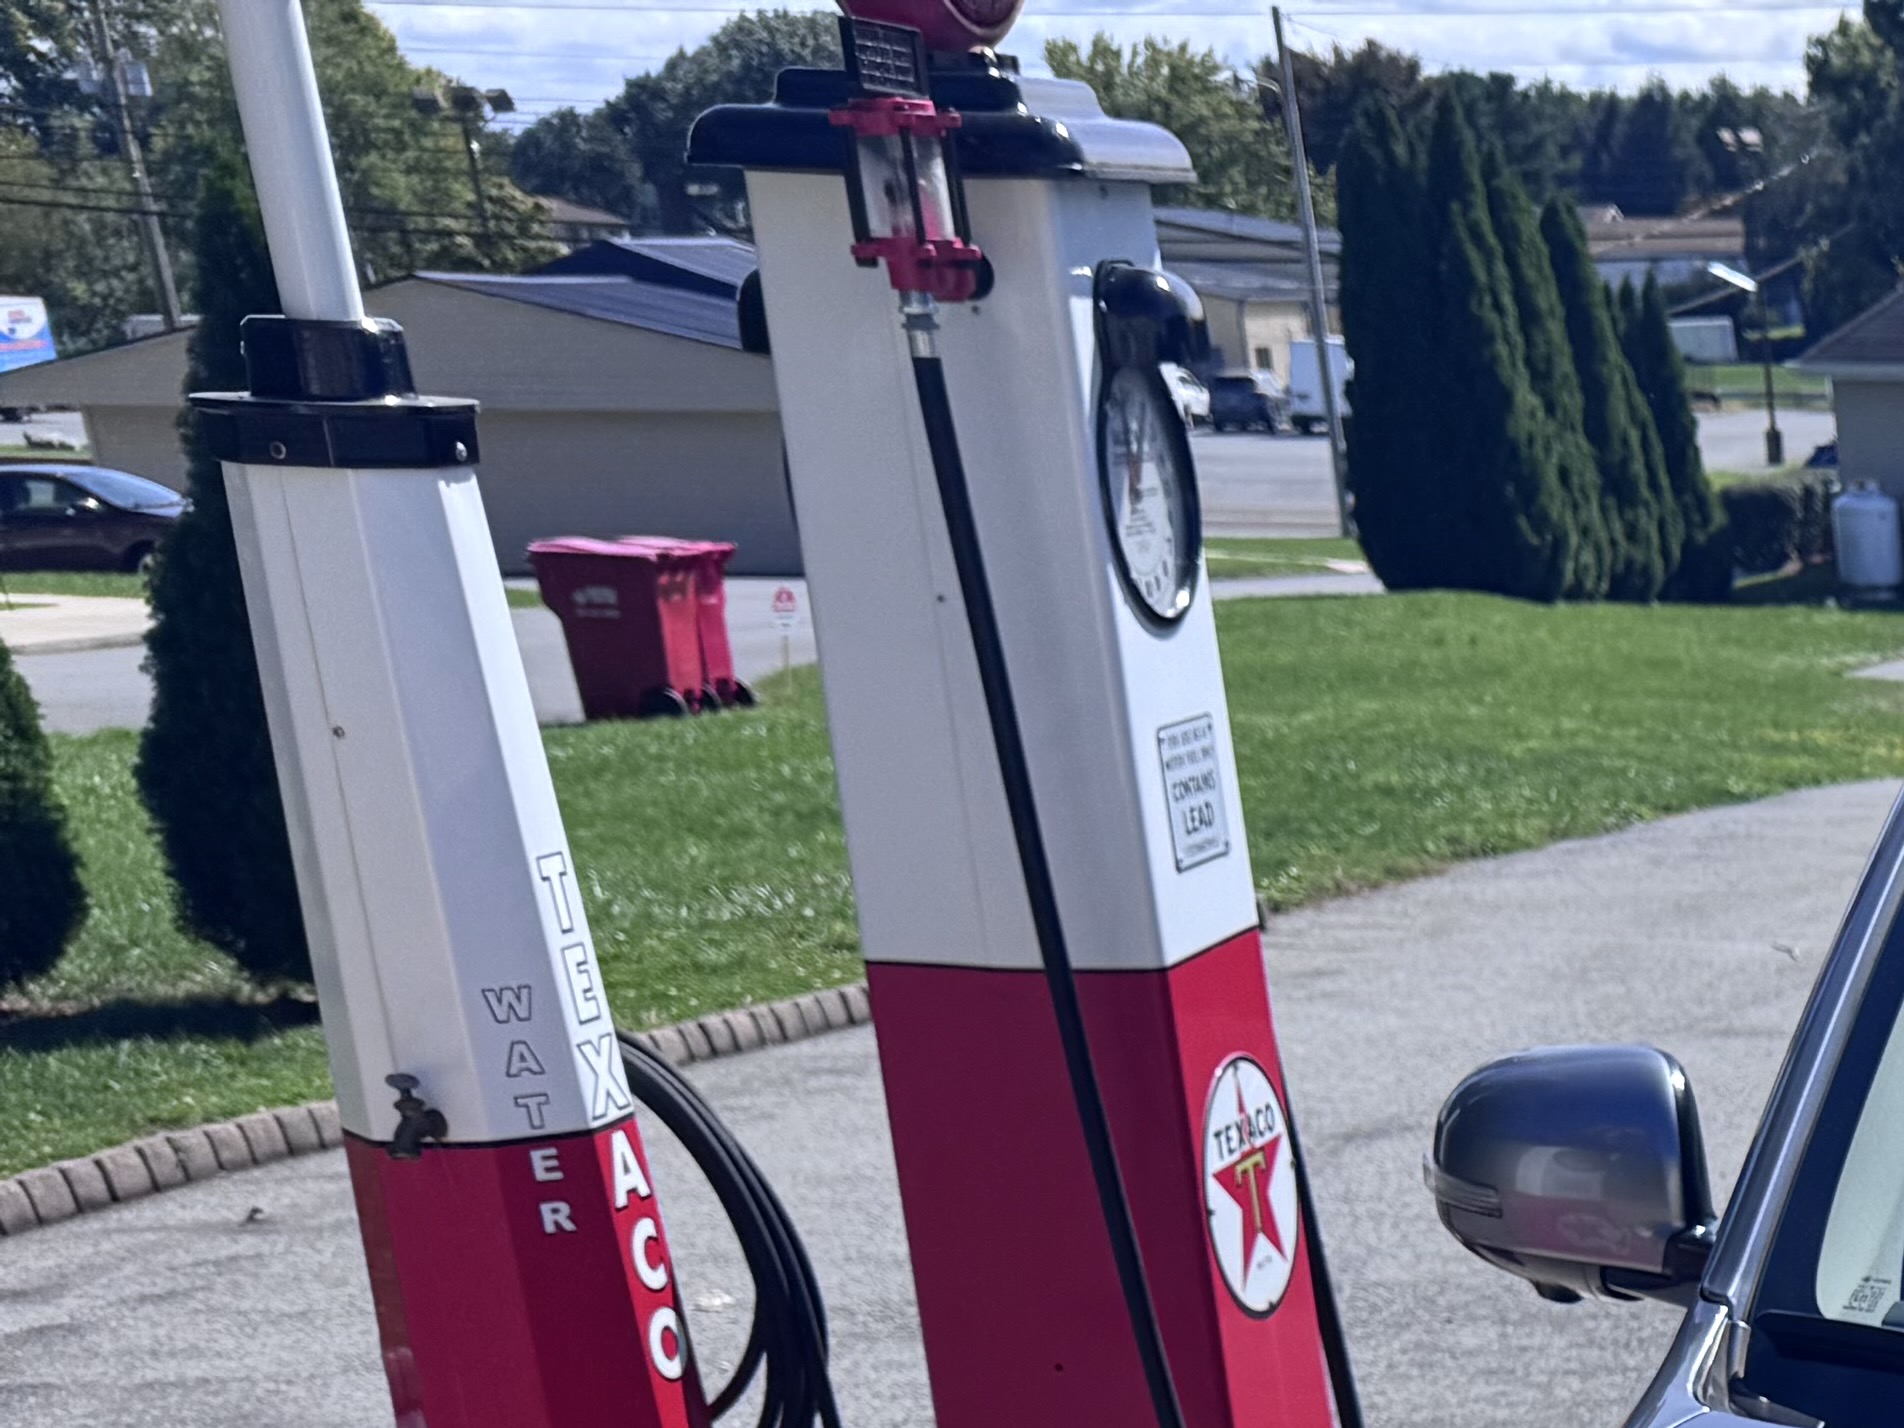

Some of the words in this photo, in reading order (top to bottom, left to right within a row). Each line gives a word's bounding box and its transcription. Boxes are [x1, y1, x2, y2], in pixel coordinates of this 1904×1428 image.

[1184, 801, 1215, 836] LEAD
[482, 985, 577, 1235] WATER
[536, 852, 687, 1380] TEXACO
[1213, 1102, 1276, 1162] TEXACO
[1234, 1150, 1268, 1234] T
